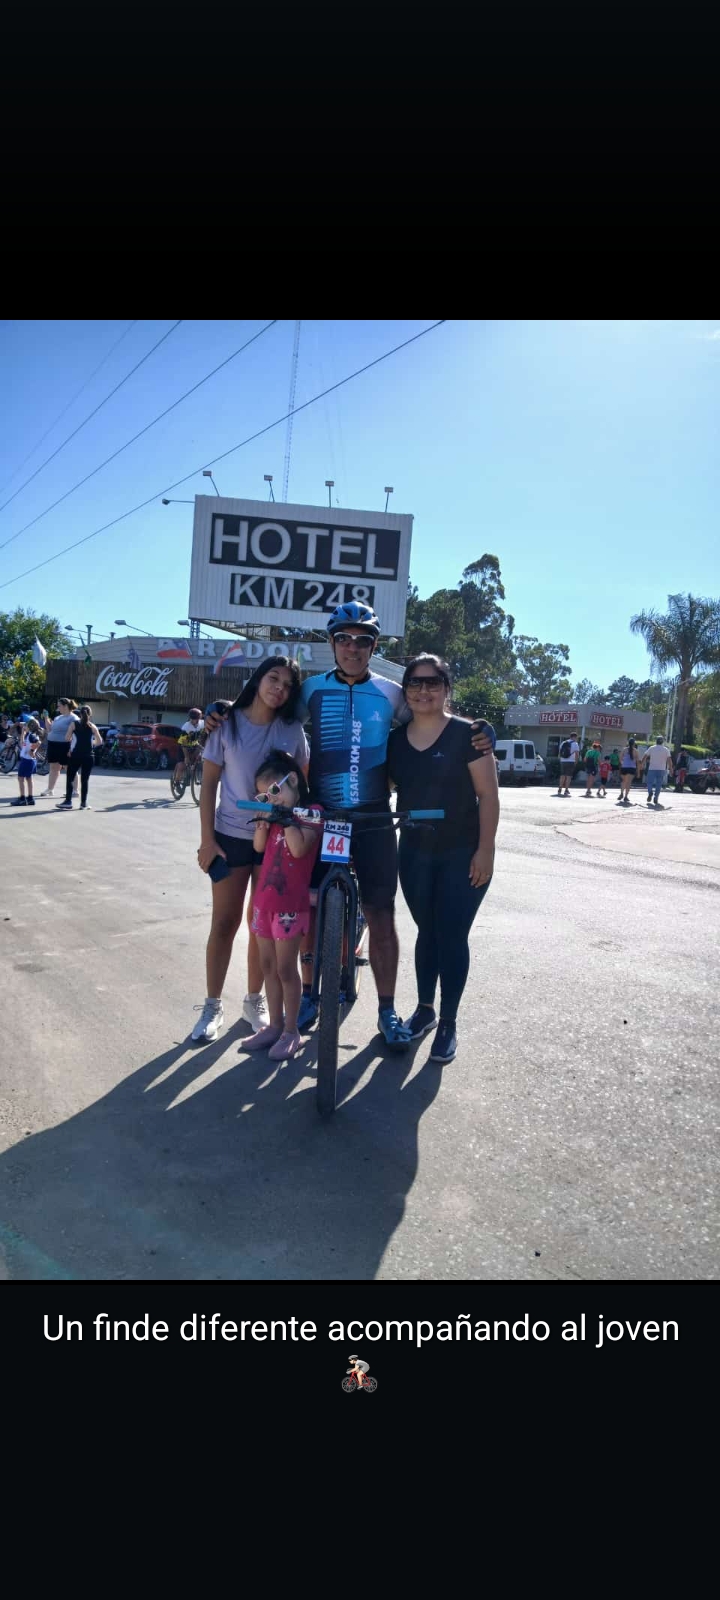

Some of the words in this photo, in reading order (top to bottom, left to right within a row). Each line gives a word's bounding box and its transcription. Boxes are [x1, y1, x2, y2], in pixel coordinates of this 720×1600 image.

[212, 517, 395, 577] HOTEL
[233, 573, 294, 609] KM
[302, 581, 370, 612] 248
[541, 712, 577, 723] HOTEL
[592, 714, 622, 728] HOTEL
[351, 720, 362, 743] 248
[350, 744, 360, 763] KM
[326, 836, 345, 854] 44
